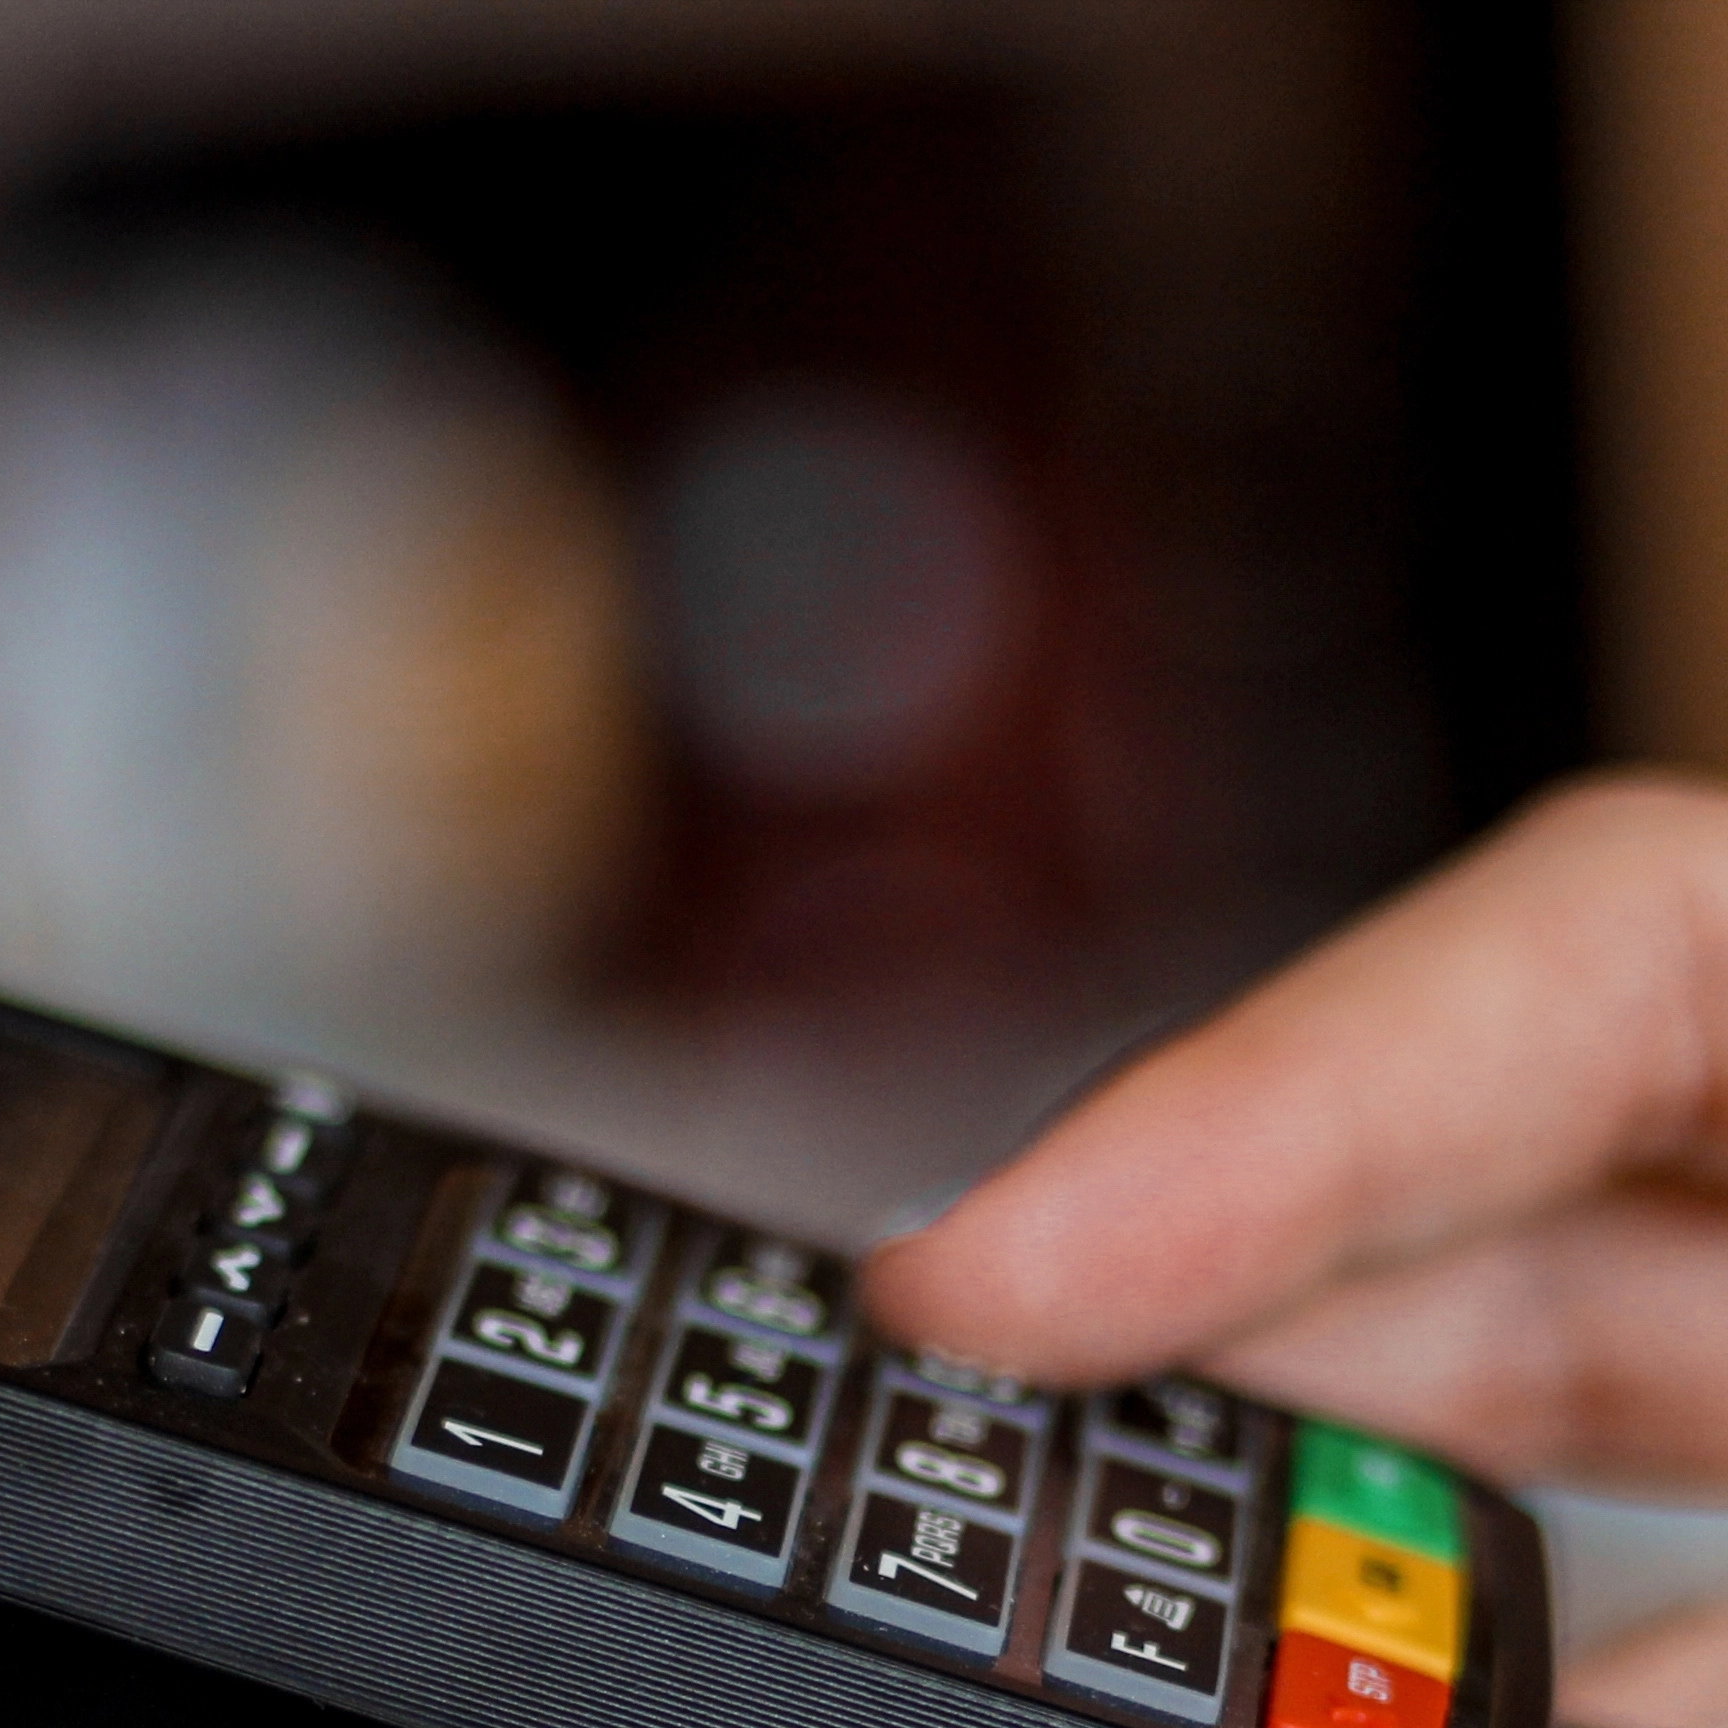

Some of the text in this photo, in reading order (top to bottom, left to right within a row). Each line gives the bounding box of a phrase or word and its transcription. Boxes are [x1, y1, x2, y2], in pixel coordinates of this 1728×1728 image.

[475, 1308, 584, 1365] 2
[684, 1373, 793, 1431] 5
[442, 1417, 544, 1457] 1
[662, 1443, 762, 1531] 4 GHI
[895, 1440, 1006, 1498] 8
[910, 1510, 965, 1568] PQRS
[878, 1551, 978, 1601] 7
[1110, 1630, 1187, 1672] F
